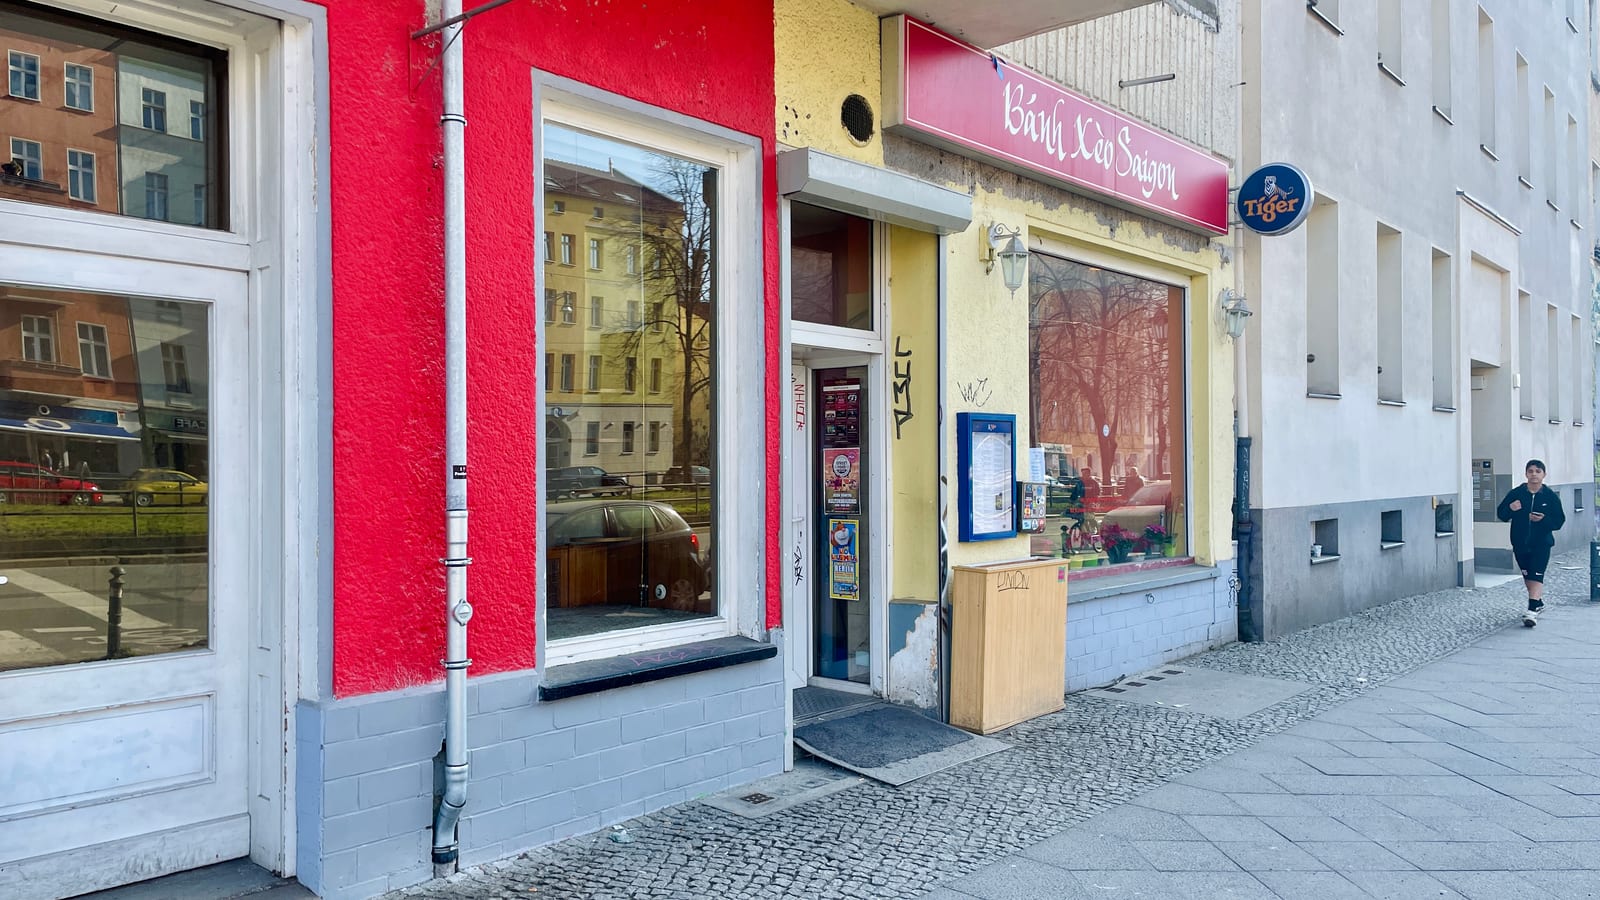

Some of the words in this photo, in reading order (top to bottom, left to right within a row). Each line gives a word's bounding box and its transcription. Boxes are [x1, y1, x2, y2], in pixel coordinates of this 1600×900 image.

[1003, 80, 1067, 161] Bánh
[1071, 113, 1113, 170] Xèo
[1116, 126, 1180, 200] Saigon
[1243, 194, 1299, 222] Tiger
